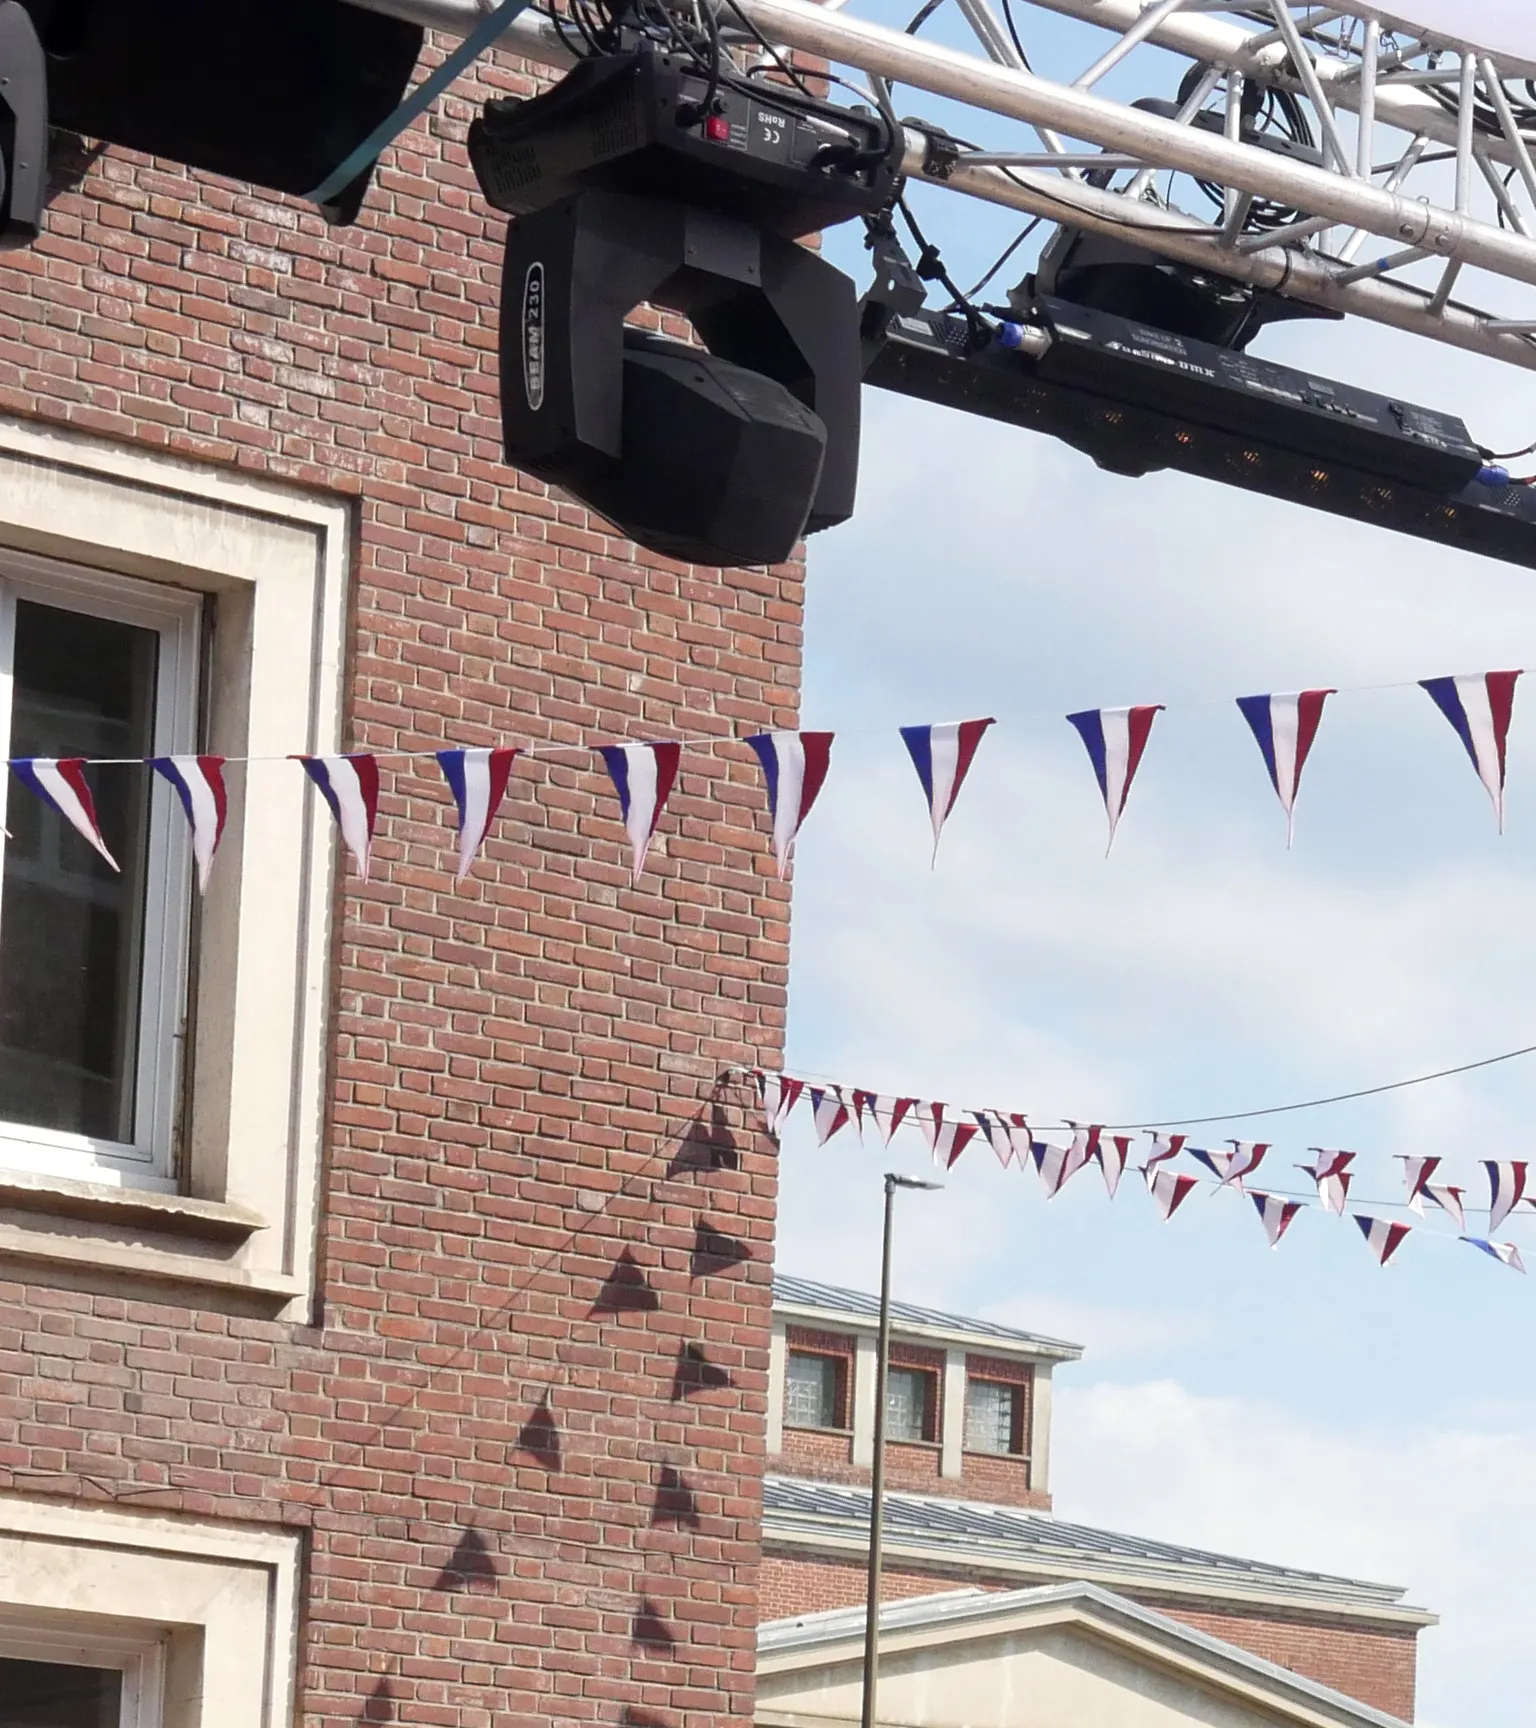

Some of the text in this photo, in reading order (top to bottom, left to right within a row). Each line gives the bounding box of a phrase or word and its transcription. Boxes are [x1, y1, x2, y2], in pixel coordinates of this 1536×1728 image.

[758, 111, 785, 128] RoHS
[528, 280, 542, 390] BEAM 230
